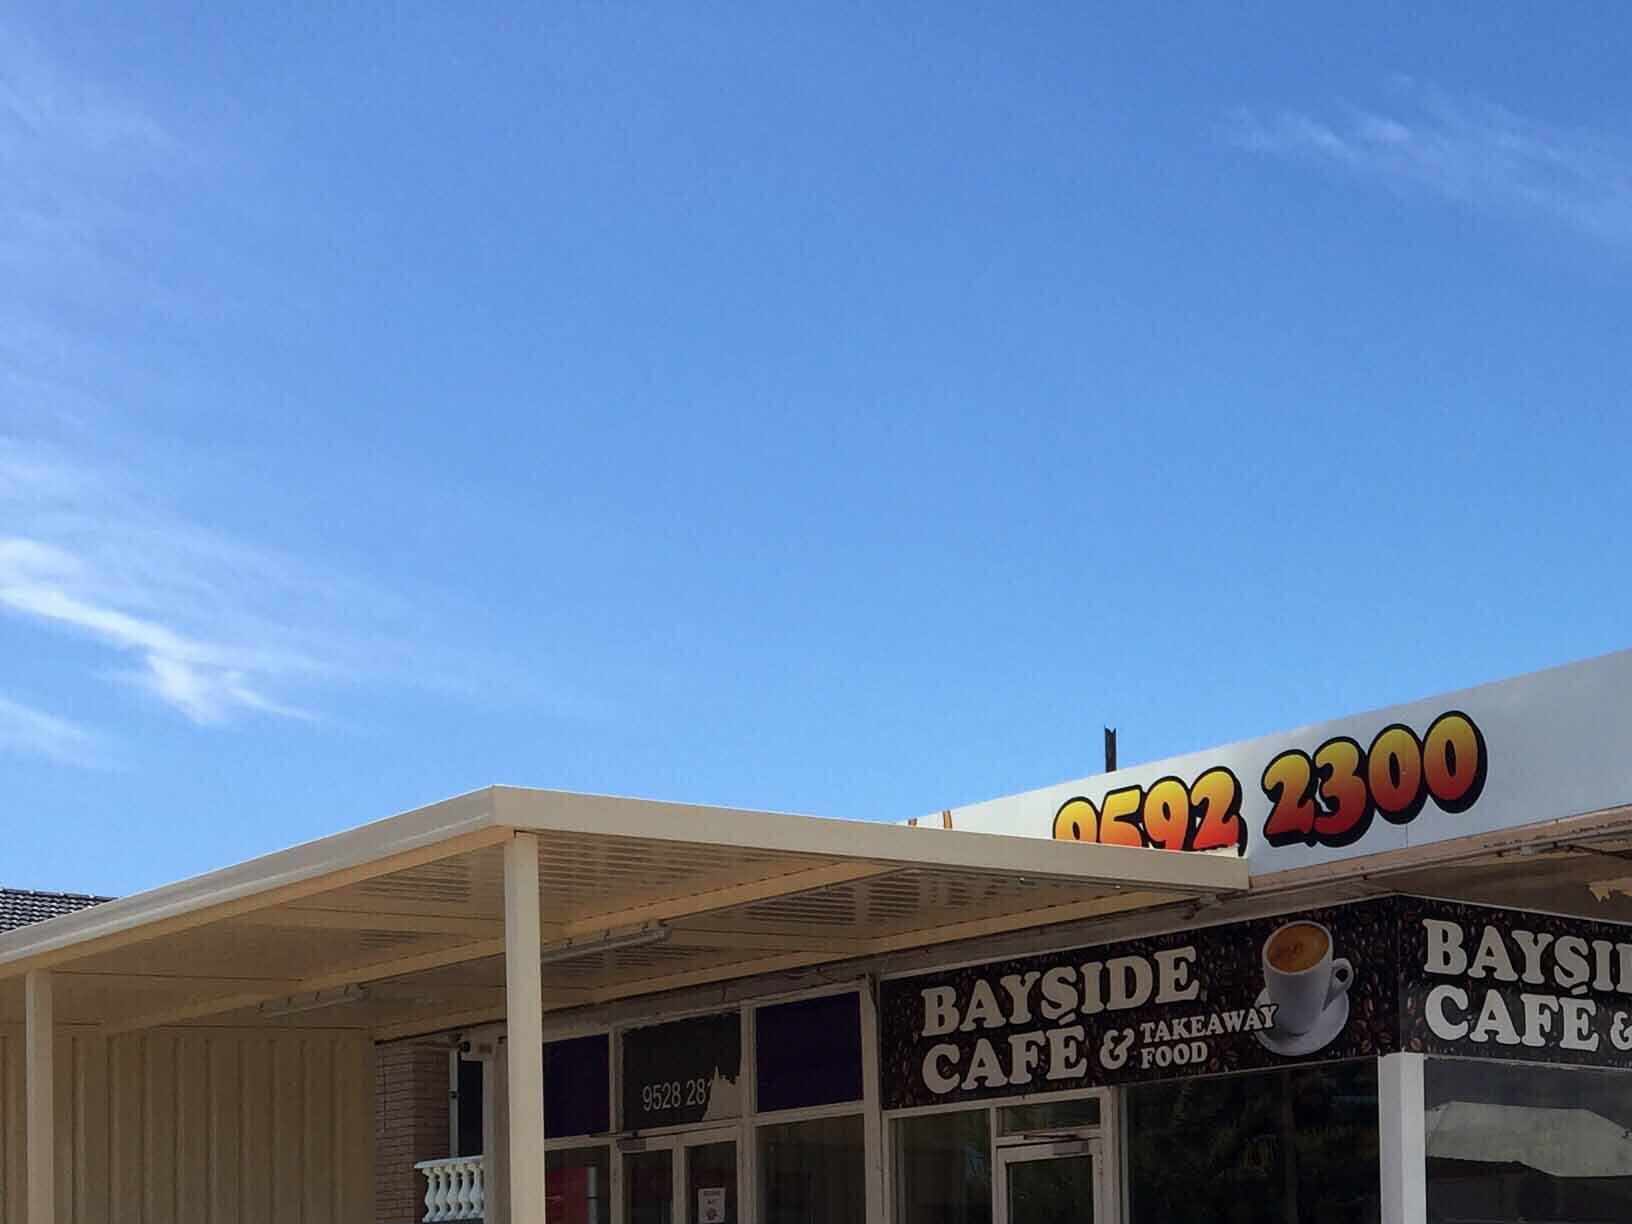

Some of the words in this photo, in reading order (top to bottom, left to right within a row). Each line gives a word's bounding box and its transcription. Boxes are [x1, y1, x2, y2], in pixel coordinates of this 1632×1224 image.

[1260, 710, 1488, 847] 2300
[921, 945, 1200, 1037] BAYSIDE
[1140, 1003, 1280, 1045] TAKEAWAY
[1425, 984, 1599, 1052] CAFÉ
[922, 1009, 1087, 1094] CAFÉ
[1100, 1030, 1136, 1070] &
[1141, 1040, 1209, 1070] FOOD
[642, 1081, 681, 1112] 9528
